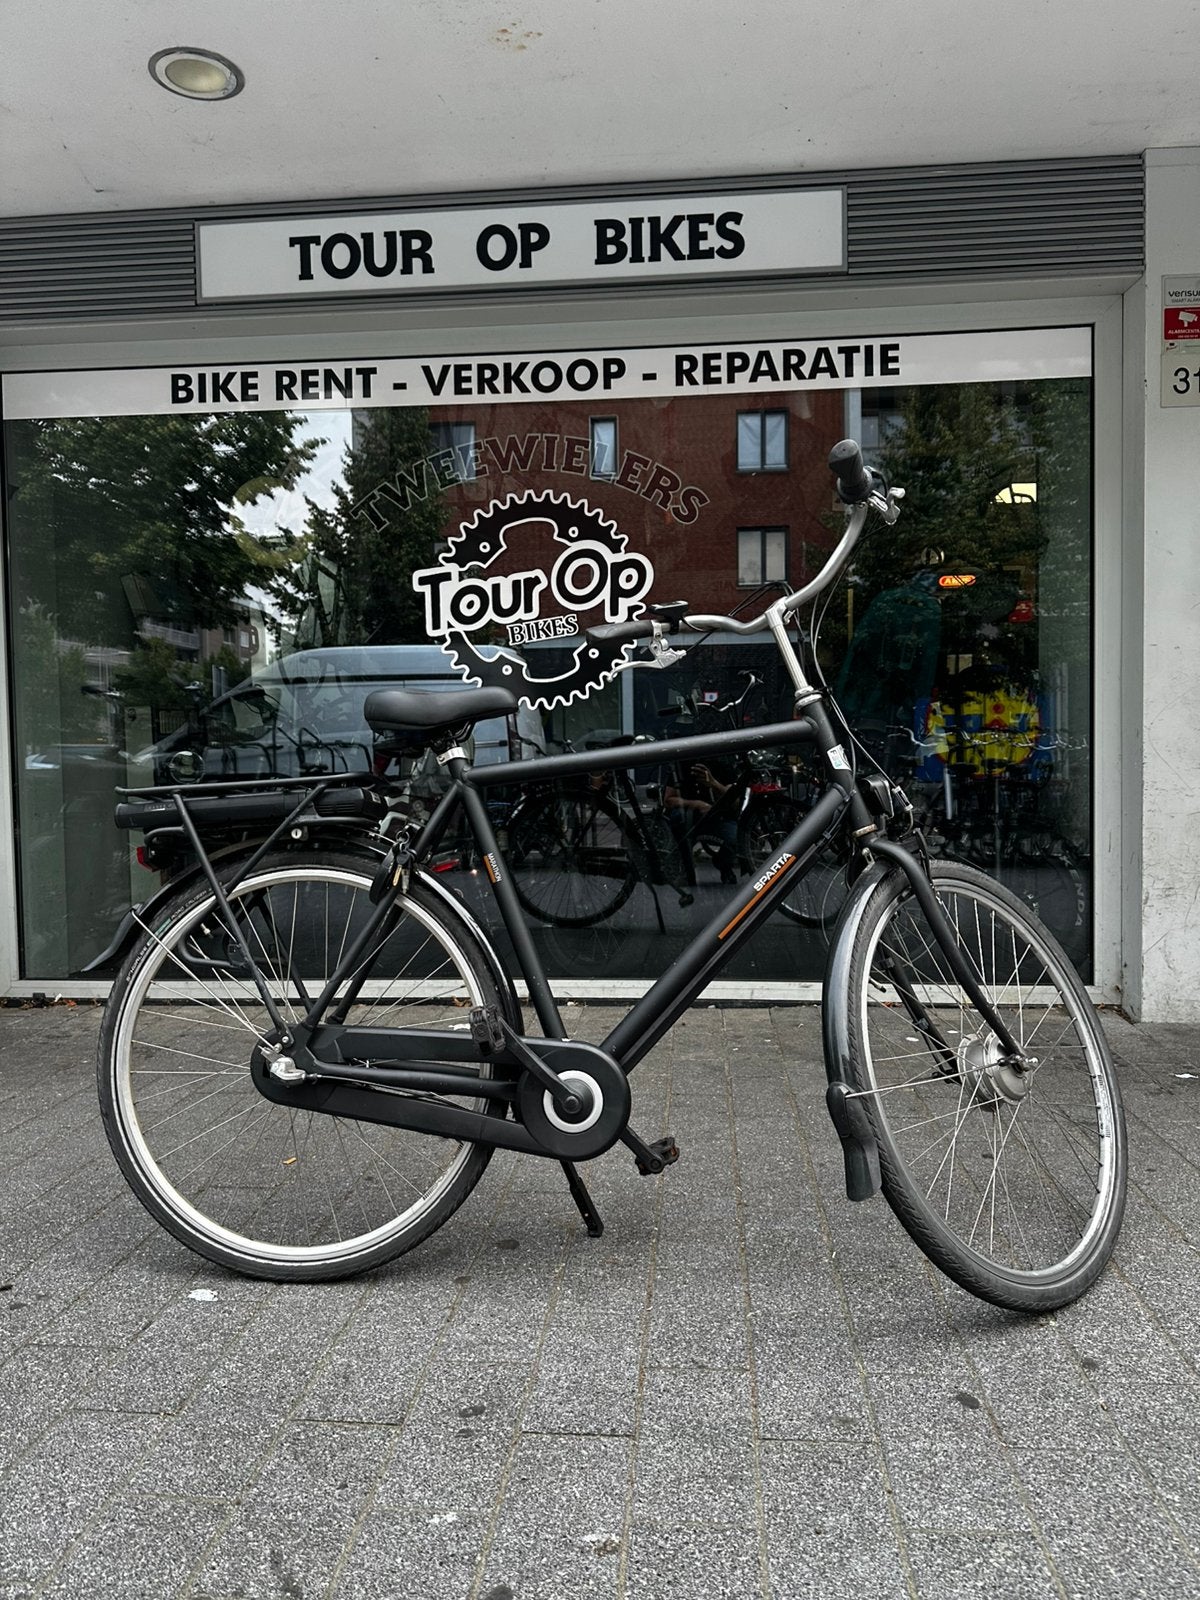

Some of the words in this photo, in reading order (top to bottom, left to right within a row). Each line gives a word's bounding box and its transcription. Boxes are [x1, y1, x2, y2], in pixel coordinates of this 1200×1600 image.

[288, 230, 434, 281] TOUR
[476, 223, 550, 271] OP
[594, 212, 746, 265] BIKES
[170, 371, 259, 404] BIKE
[275, 367, 378, 401] RENT
[421, 358, 627, 397] VERKOOP
[675, 345, 901, 387] REPARATIE
[350, 433, 710, 532] TWEEWIELERS
[413, 563, 548, 636] Tour
[550, 540, 654, 622] Op
[508, 613, 579, 646] BIKES
[487, 852, 502, 882] MARATHON
[753, 852, 793, 892] SPARTA
